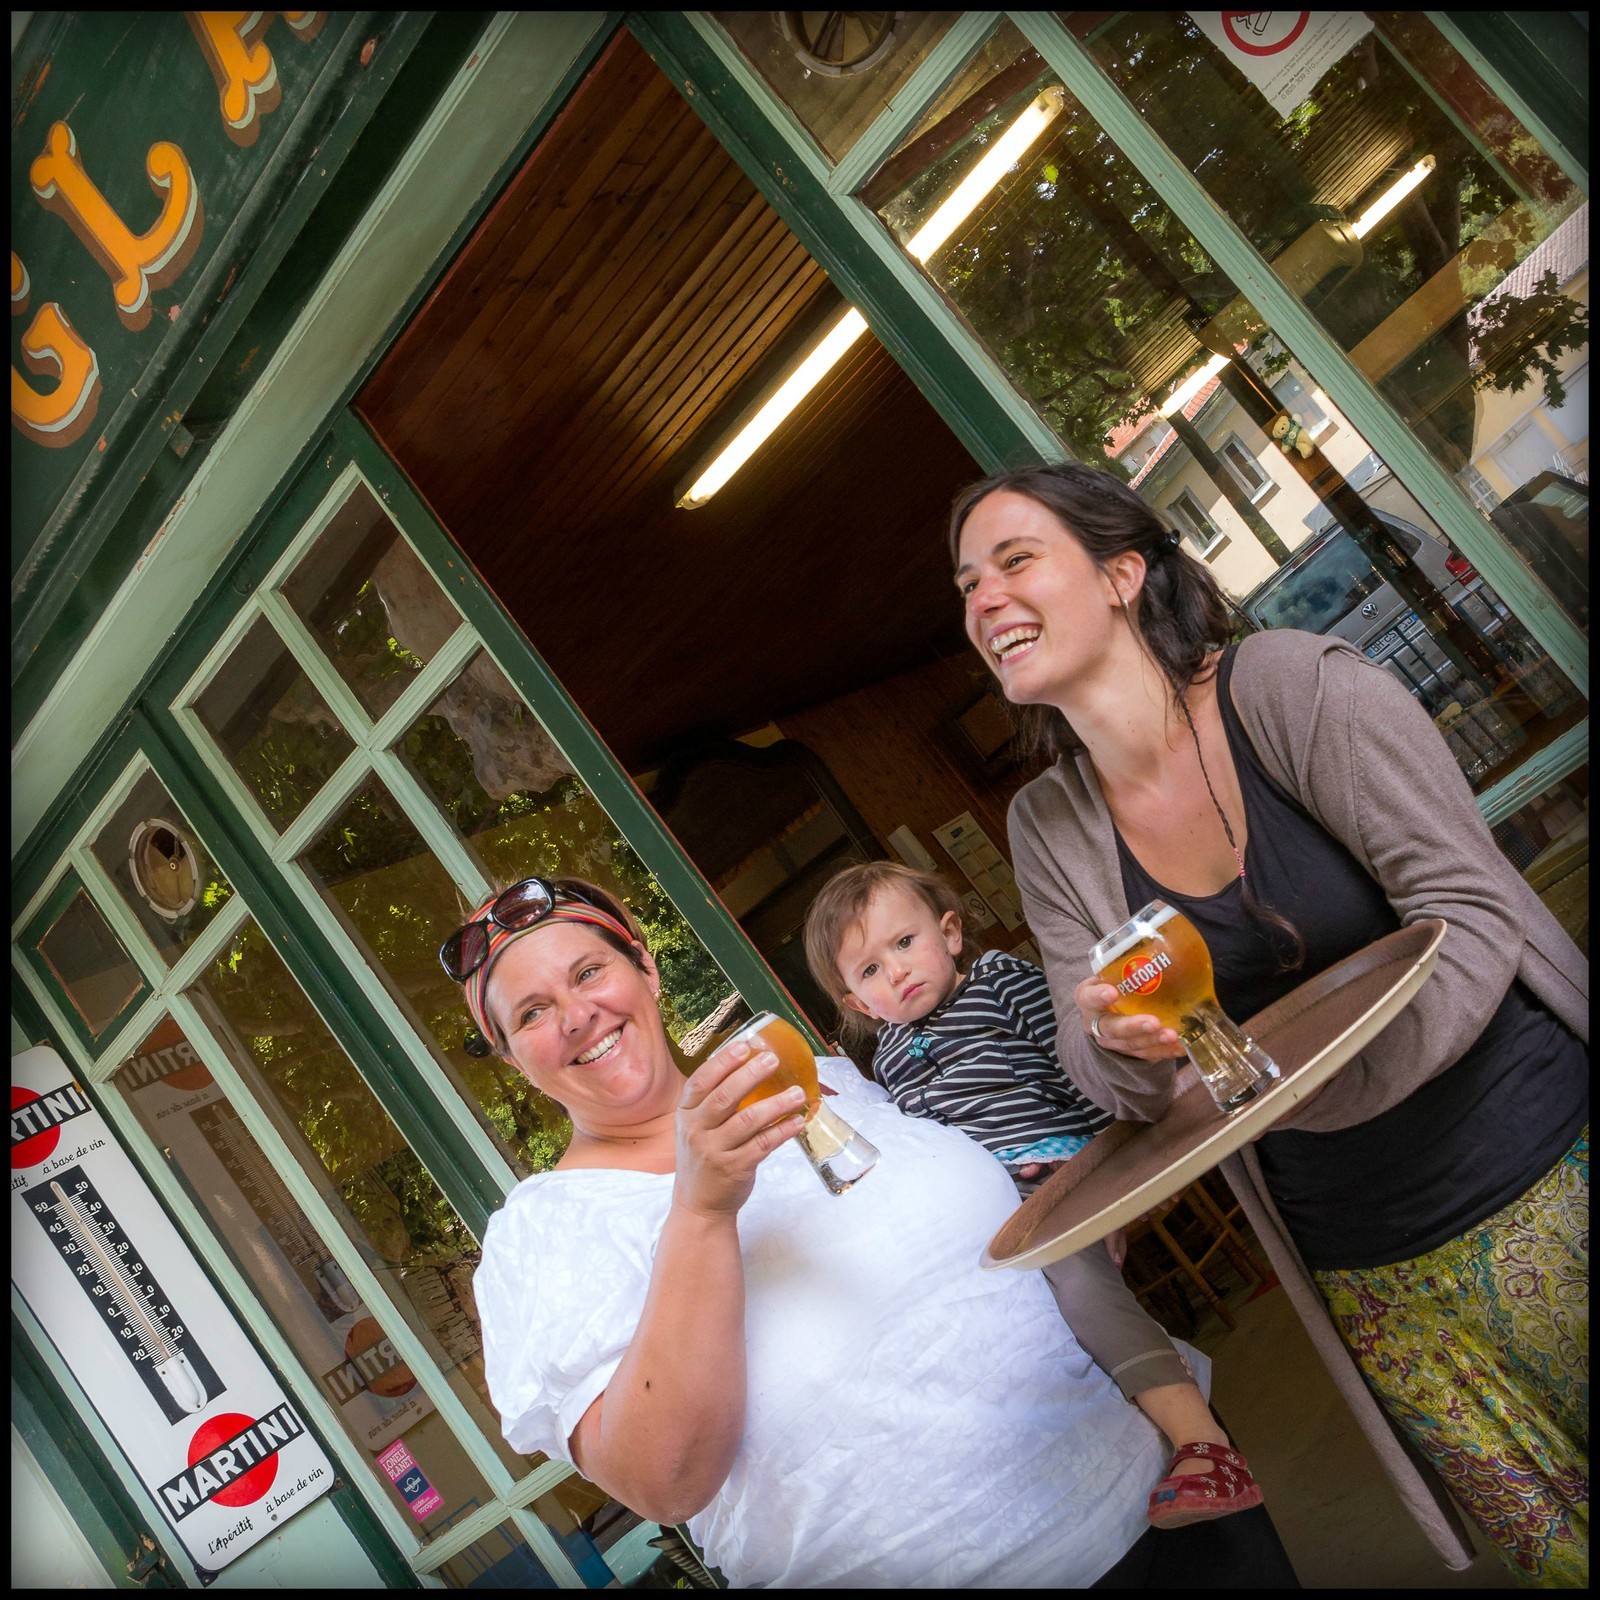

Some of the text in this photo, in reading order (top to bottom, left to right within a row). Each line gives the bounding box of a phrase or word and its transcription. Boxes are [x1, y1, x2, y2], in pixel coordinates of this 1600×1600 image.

[1116, 951, 1172, 997] PELFORTH
[42, 1163, 51, 1175] à
[53, 1154, 75, 1169] base
[76, 1146, 88, 1159] de
[89, 1139, 106, 1151] vin
[75, 1181, 89, 1192] 50
[35, 1201, 48, 1213] 50
[89, 1201, 102, 1212] 40
[50, 1222, 62, 1234] 40
[103, 1221, 116, 1232] 30
[62, 1243, 76, 1254] 30
[116, 1242, 129, 1253] 20
[76, 1264, 90, 1275] 20
[132, 1262, 143, 1273] 10
[92, 1285, 104, 1296] 10
[146, 1285, 155, 1294] 0
[107, 1307, 115, 1316] 0
[159, 1304, 170, 1315] 10
[120, 1328, 132, 1339] 10
[171, 1325, 184, 1336] 20
[132, 1349, 145, 1361] 20
[162, 1407, 300, 1516] MARTINI
[382, 1446, 408, 1472] LONELY
[388, 1455, 413, 1480] PLANET
[266, 1501, 274, 1515] à
[275, 1487, 296, 1507] base
[297, 1479, 308, 1493] de
[308, 1466, 324, 1482] vin
